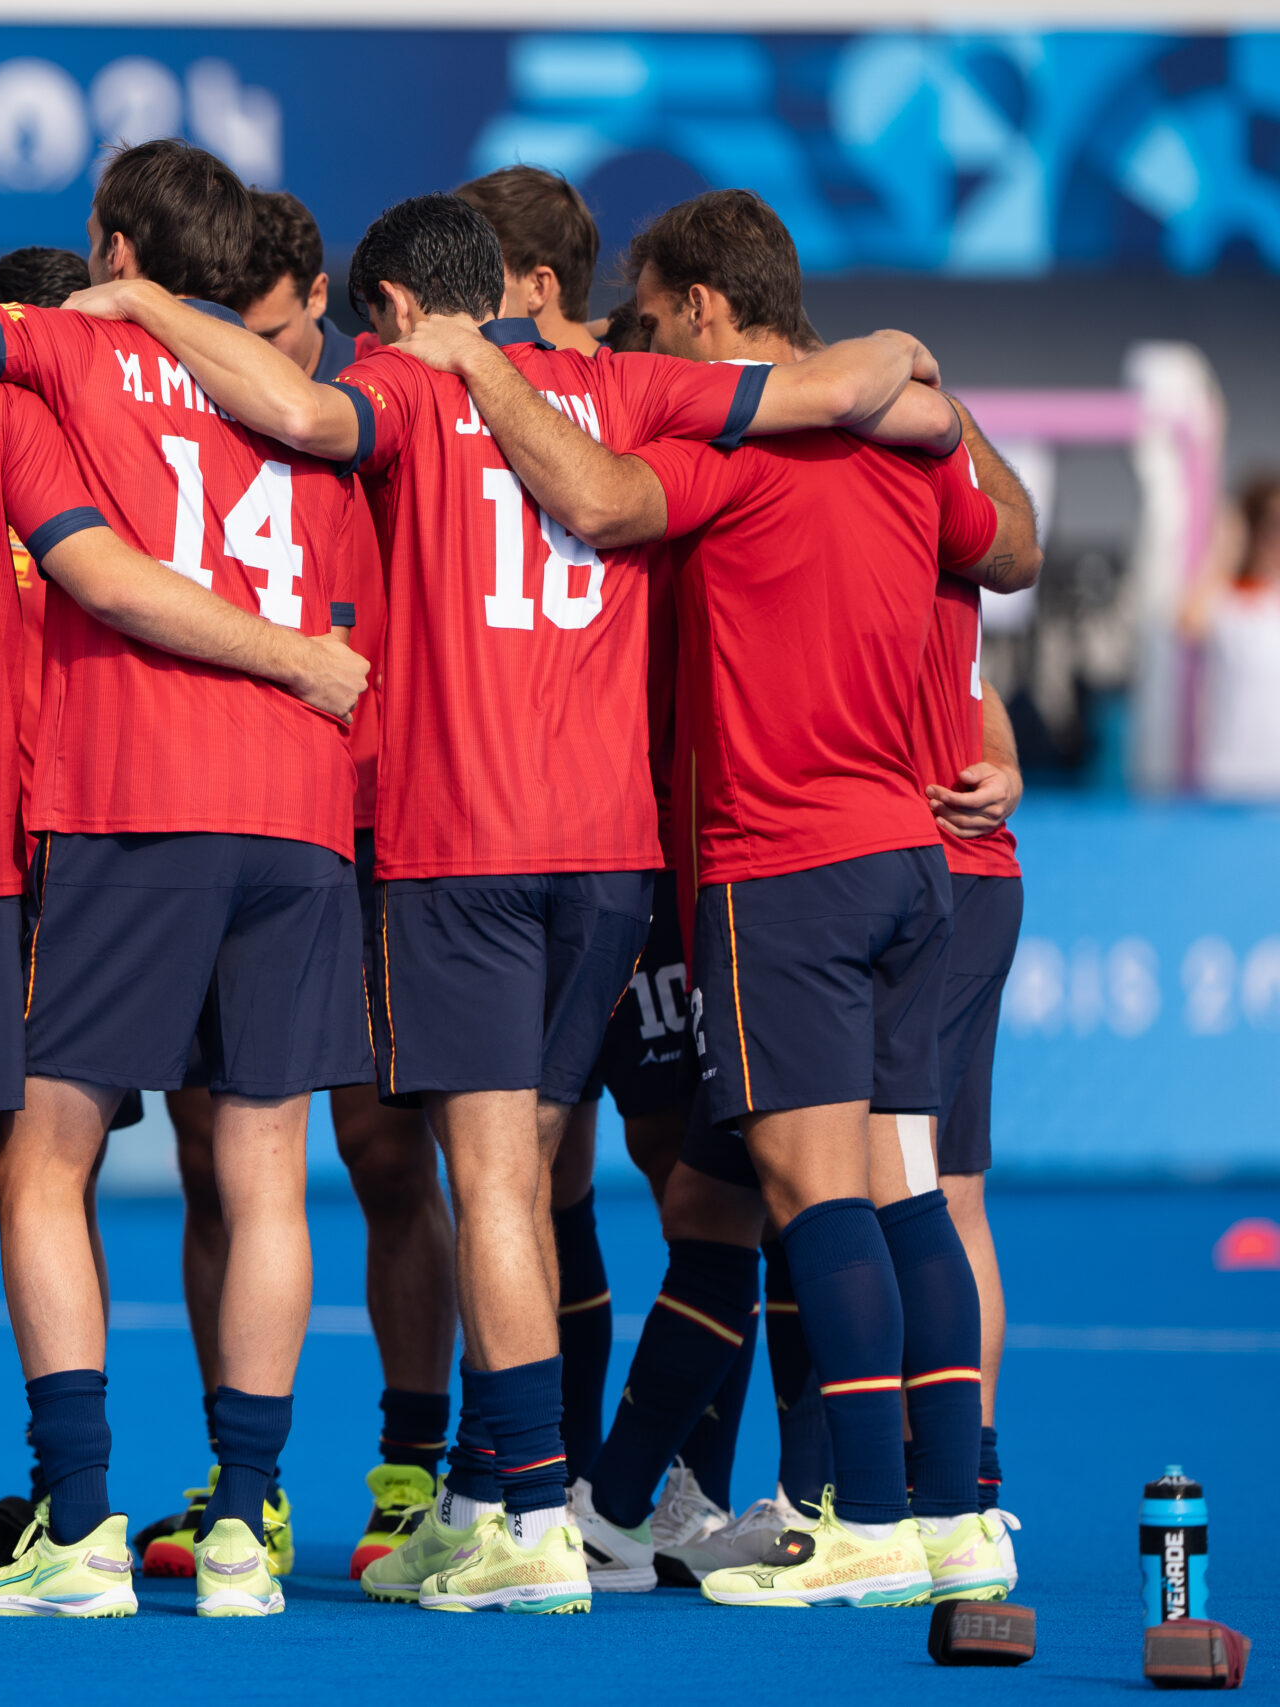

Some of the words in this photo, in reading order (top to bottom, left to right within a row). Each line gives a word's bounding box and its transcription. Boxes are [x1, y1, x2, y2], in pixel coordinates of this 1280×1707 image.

[159, 434, 303, 629] 14
[482, 467, 605, 631] 18
[629, 963, 688, 1040] 10
